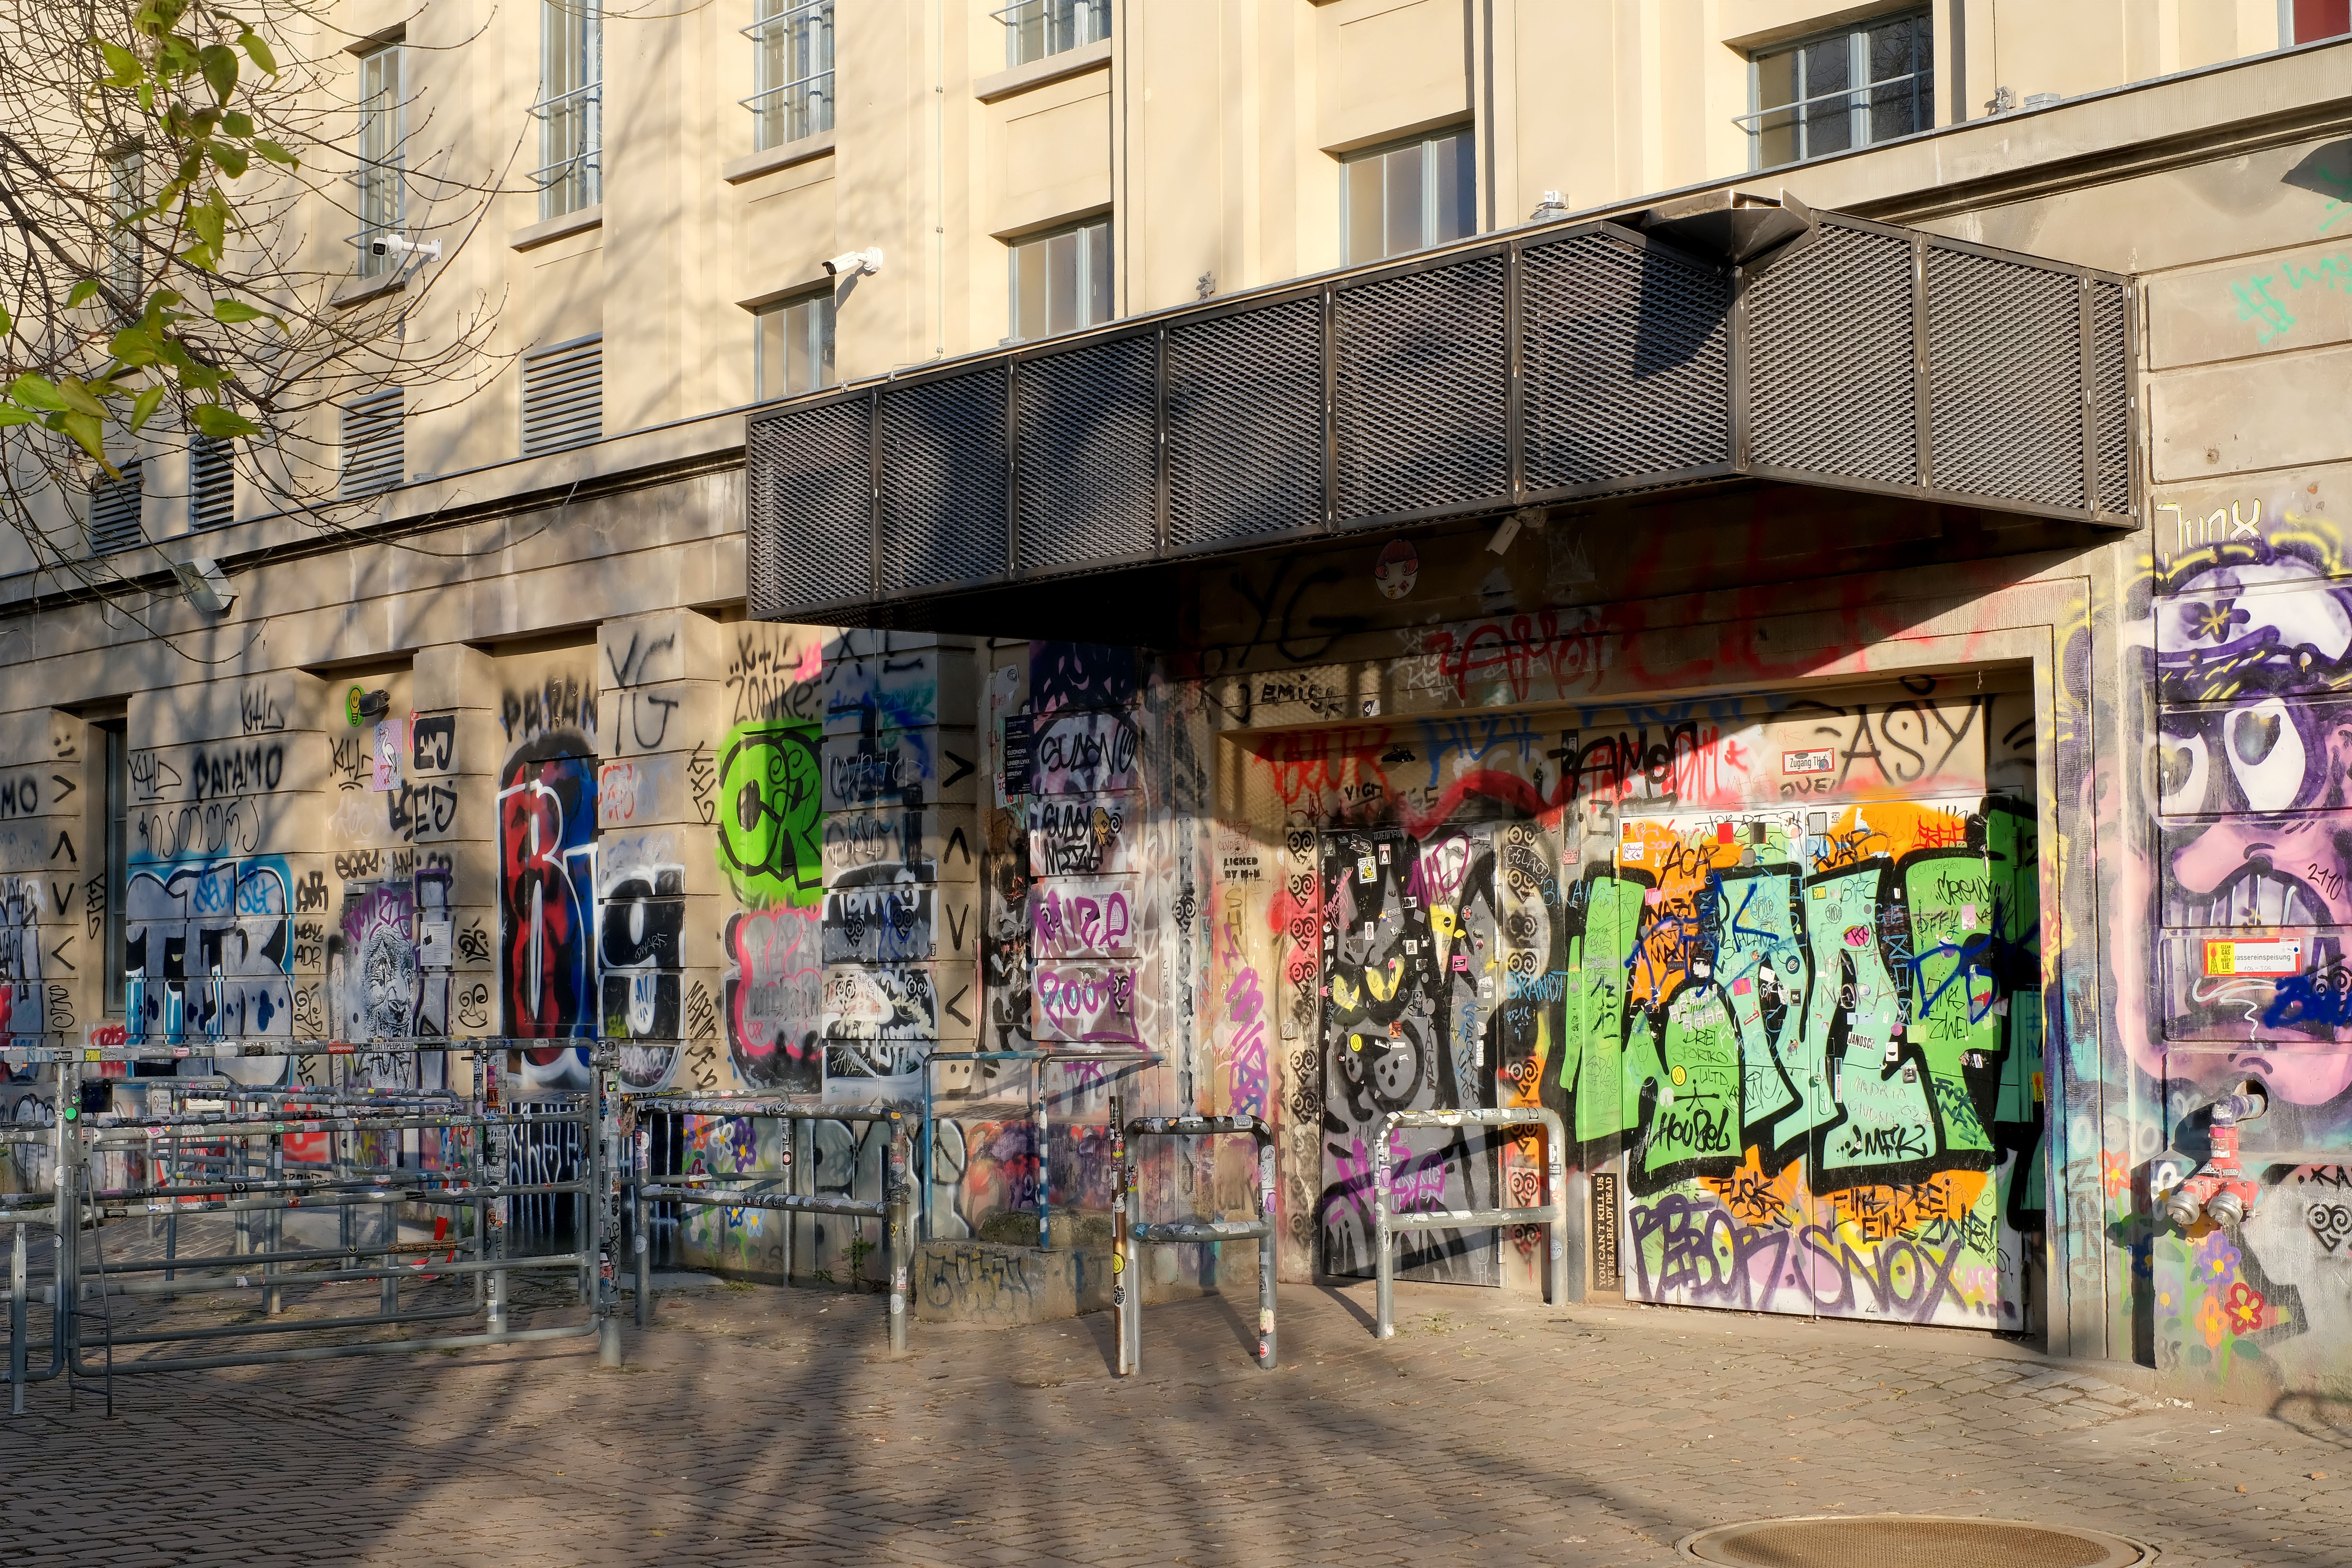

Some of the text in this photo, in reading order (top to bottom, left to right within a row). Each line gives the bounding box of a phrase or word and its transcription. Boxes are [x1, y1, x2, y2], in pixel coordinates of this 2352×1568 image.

[1790, 757, 1811, 769] Zugang
[1223, 857, 1258, 867] LICKED
[1225, 870, 1238, 880] BY
[1507, 971, 1568, 1002] BRANDT
[1597, 1177, 1604, 1191] US
